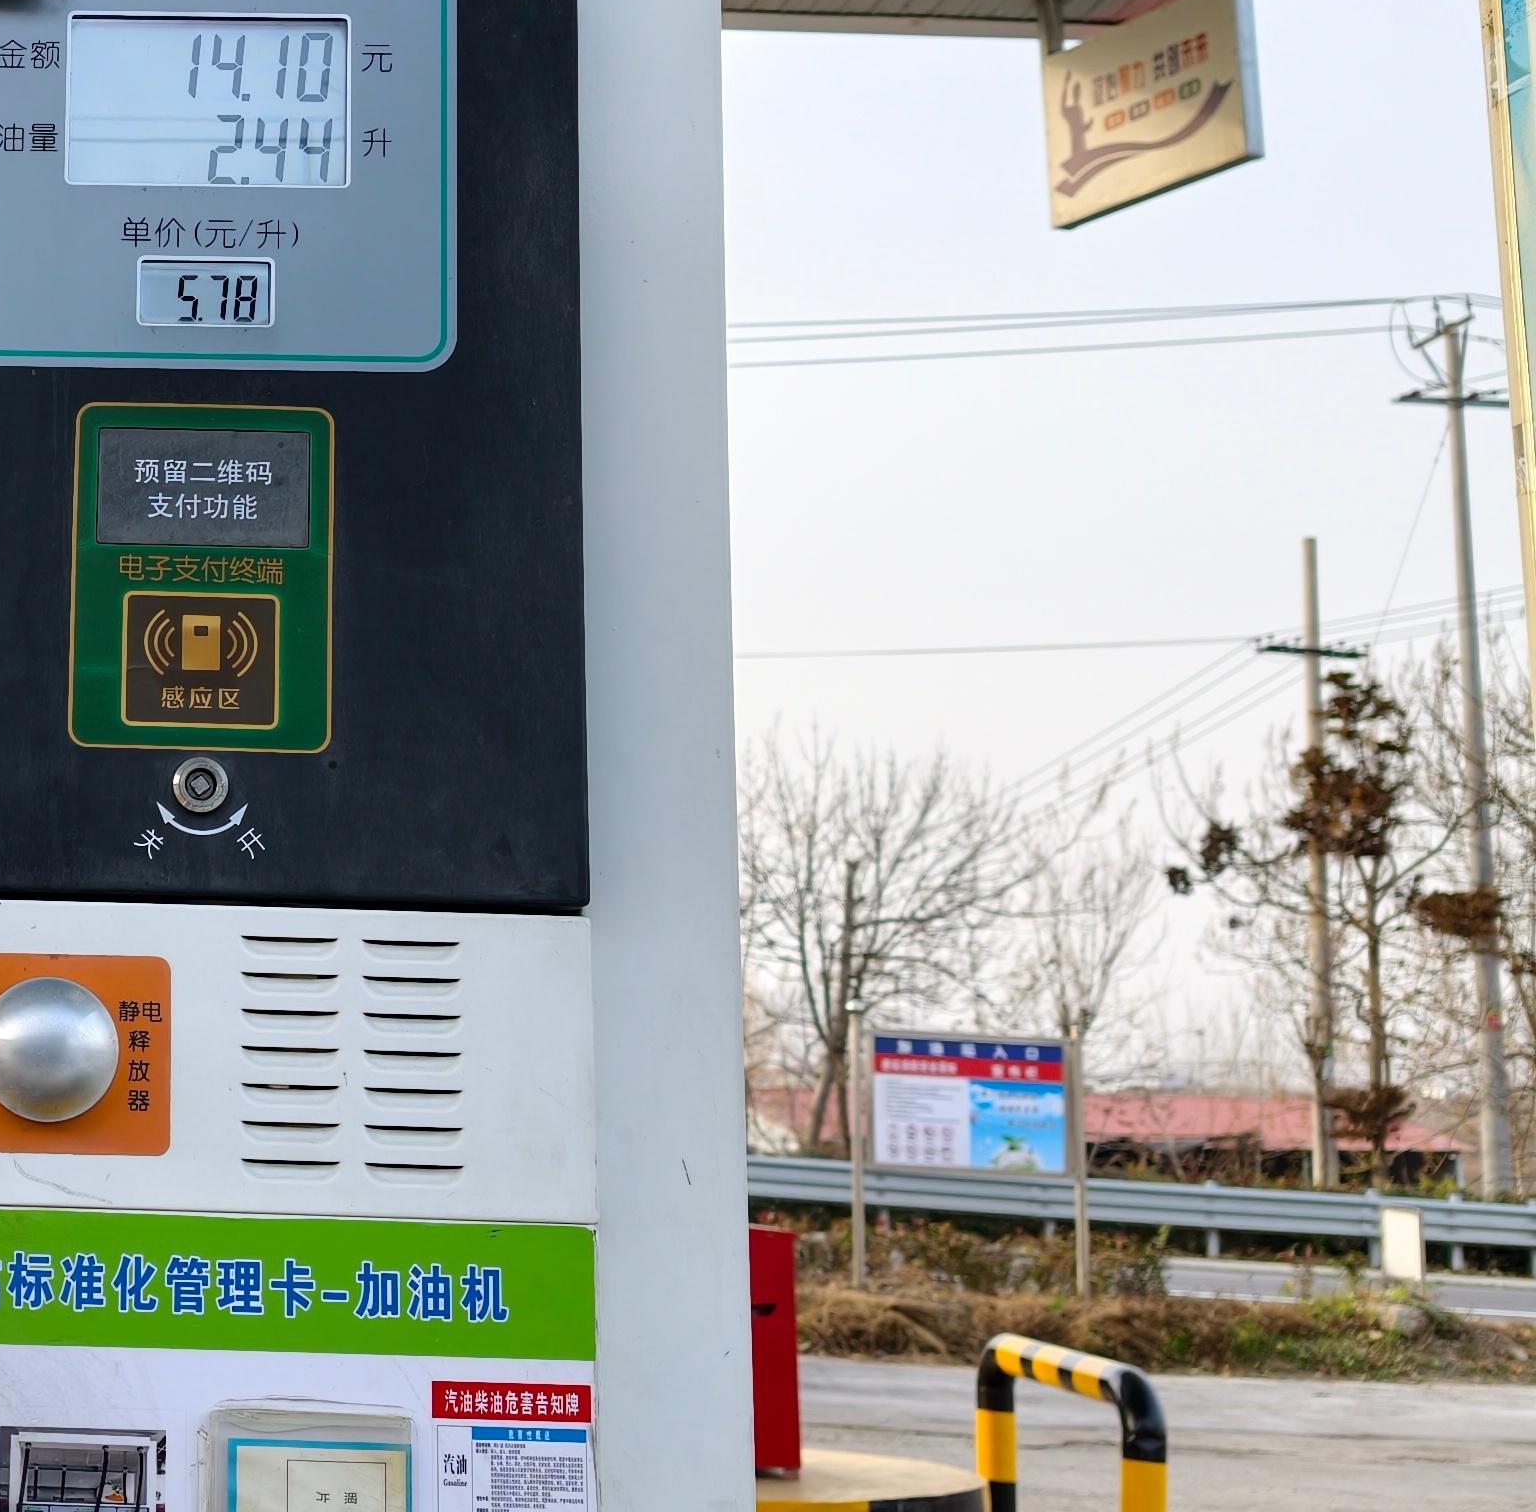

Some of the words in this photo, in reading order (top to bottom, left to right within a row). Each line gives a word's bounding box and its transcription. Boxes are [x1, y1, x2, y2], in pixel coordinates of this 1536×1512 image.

[187, 32, 334, 103] 14.10
[362, 42, 394, 74] 元
[207, 114, 334, 186] 2.44
[363, 127, 393, 159] 升
[120, 217, 300, 250] 单价(元/升)
[177, 274, 259, 324] 5.78
[133, 458, 274, 486] 预留二维码
[147, 493, 259, 522] 支付功能
[117, 554, 285, 586] 电子支付终端
[159, 685, 241, 711] 感应区
[132, 827, 166, 860] 关
[236, 827, 267, 860] 开
[118, 1000, 163, 1023] 静电
[127, 1030, 151, 1112] 释放器
[444, 1388, 580, 1417] 汽油柴油危害告知牌
[443, 1453, 468, 1476] 汽油
[315, 1490, 358, 1505] 照片
[443, 1478, 468, 1487] Gasoline
